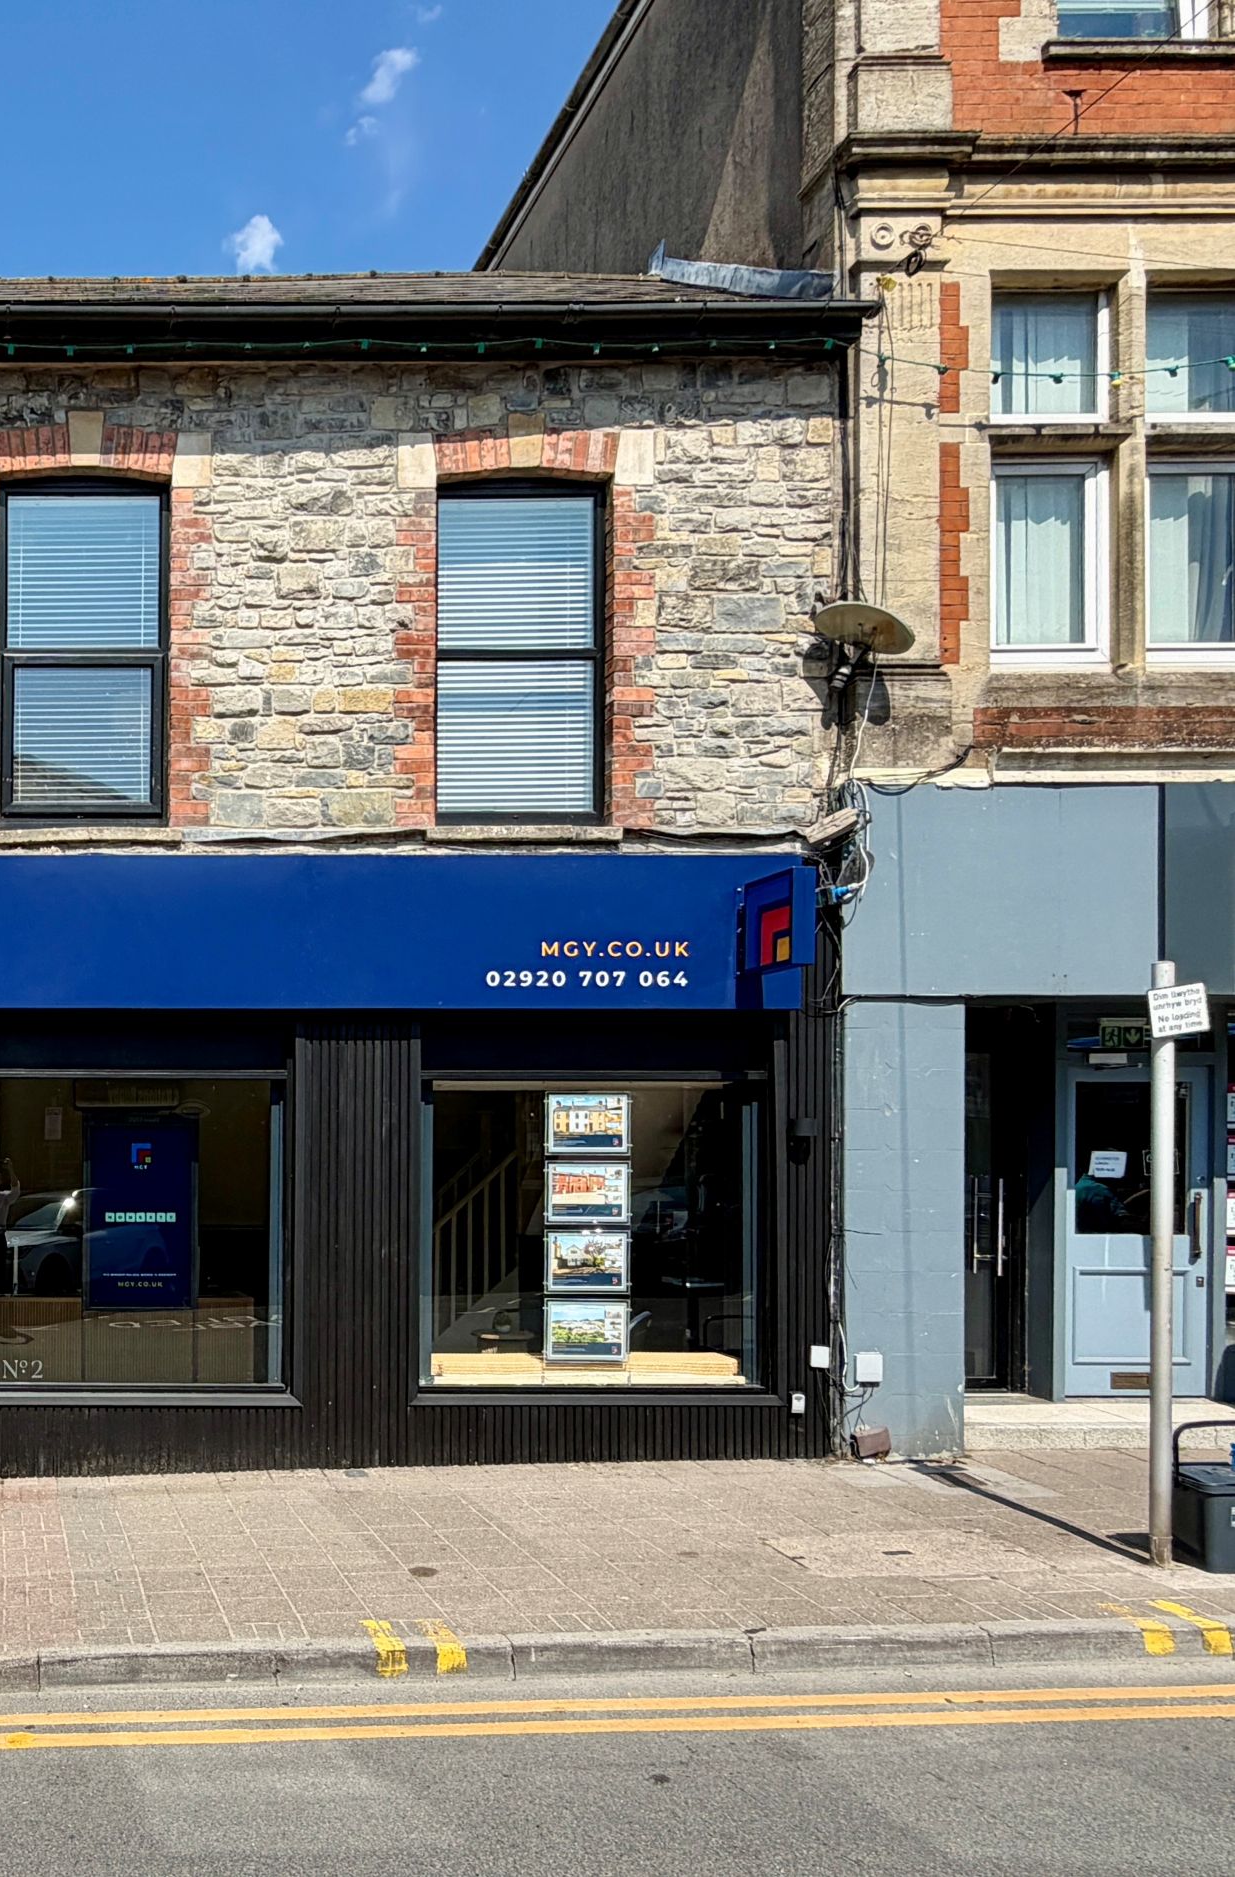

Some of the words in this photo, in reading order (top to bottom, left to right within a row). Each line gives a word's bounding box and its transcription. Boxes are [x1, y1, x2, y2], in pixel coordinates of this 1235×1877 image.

[541, 941, 689, 957] MGY.CO.UK
[485, 970, 567, 987] 02920
[578, 970, 626, 987] 707
[639, 970, 688, 987] 064
[1153, 993, 1169, 1001] Dim
[1184, 997, 1202, 1006] bryd
[1158, 1015, 1170, 1023] No
[1172, 1010, 1201, 1021] loading
[1158, 1025, 1166, 1033] at
[1169, 1024, 1182, 1032] any
